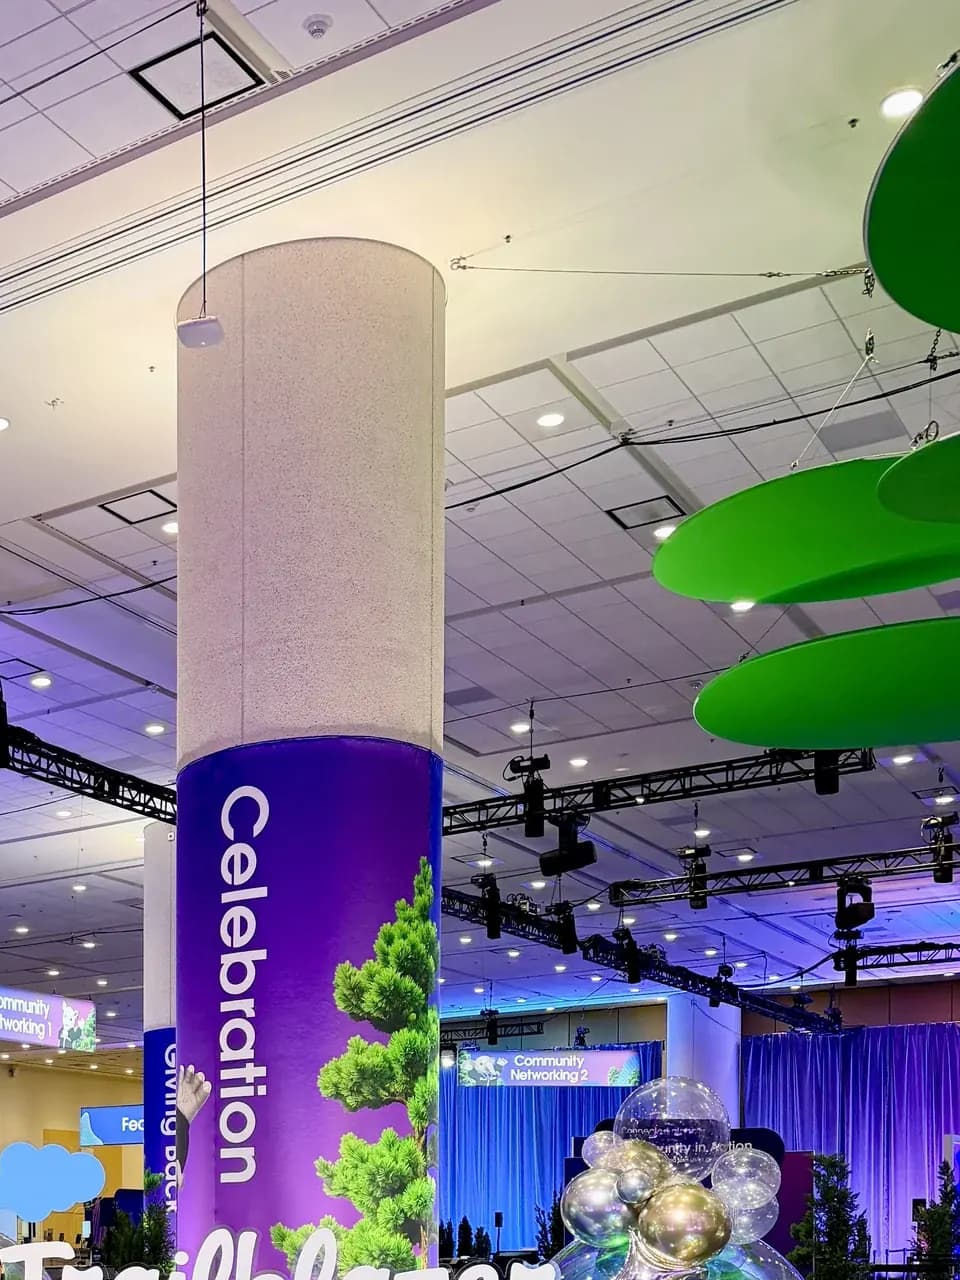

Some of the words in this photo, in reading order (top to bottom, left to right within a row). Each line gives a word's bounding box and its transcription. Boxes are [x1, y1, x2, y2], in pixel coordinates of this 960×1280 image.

[218, 785, 270, 1183] Celebration
[47, 1021, 52, 1037] 1
[514, 1055, 585, 1069] Community
[510, 1069, 578, 1083] Networking
[580, 1069, 589, 1081] 2
